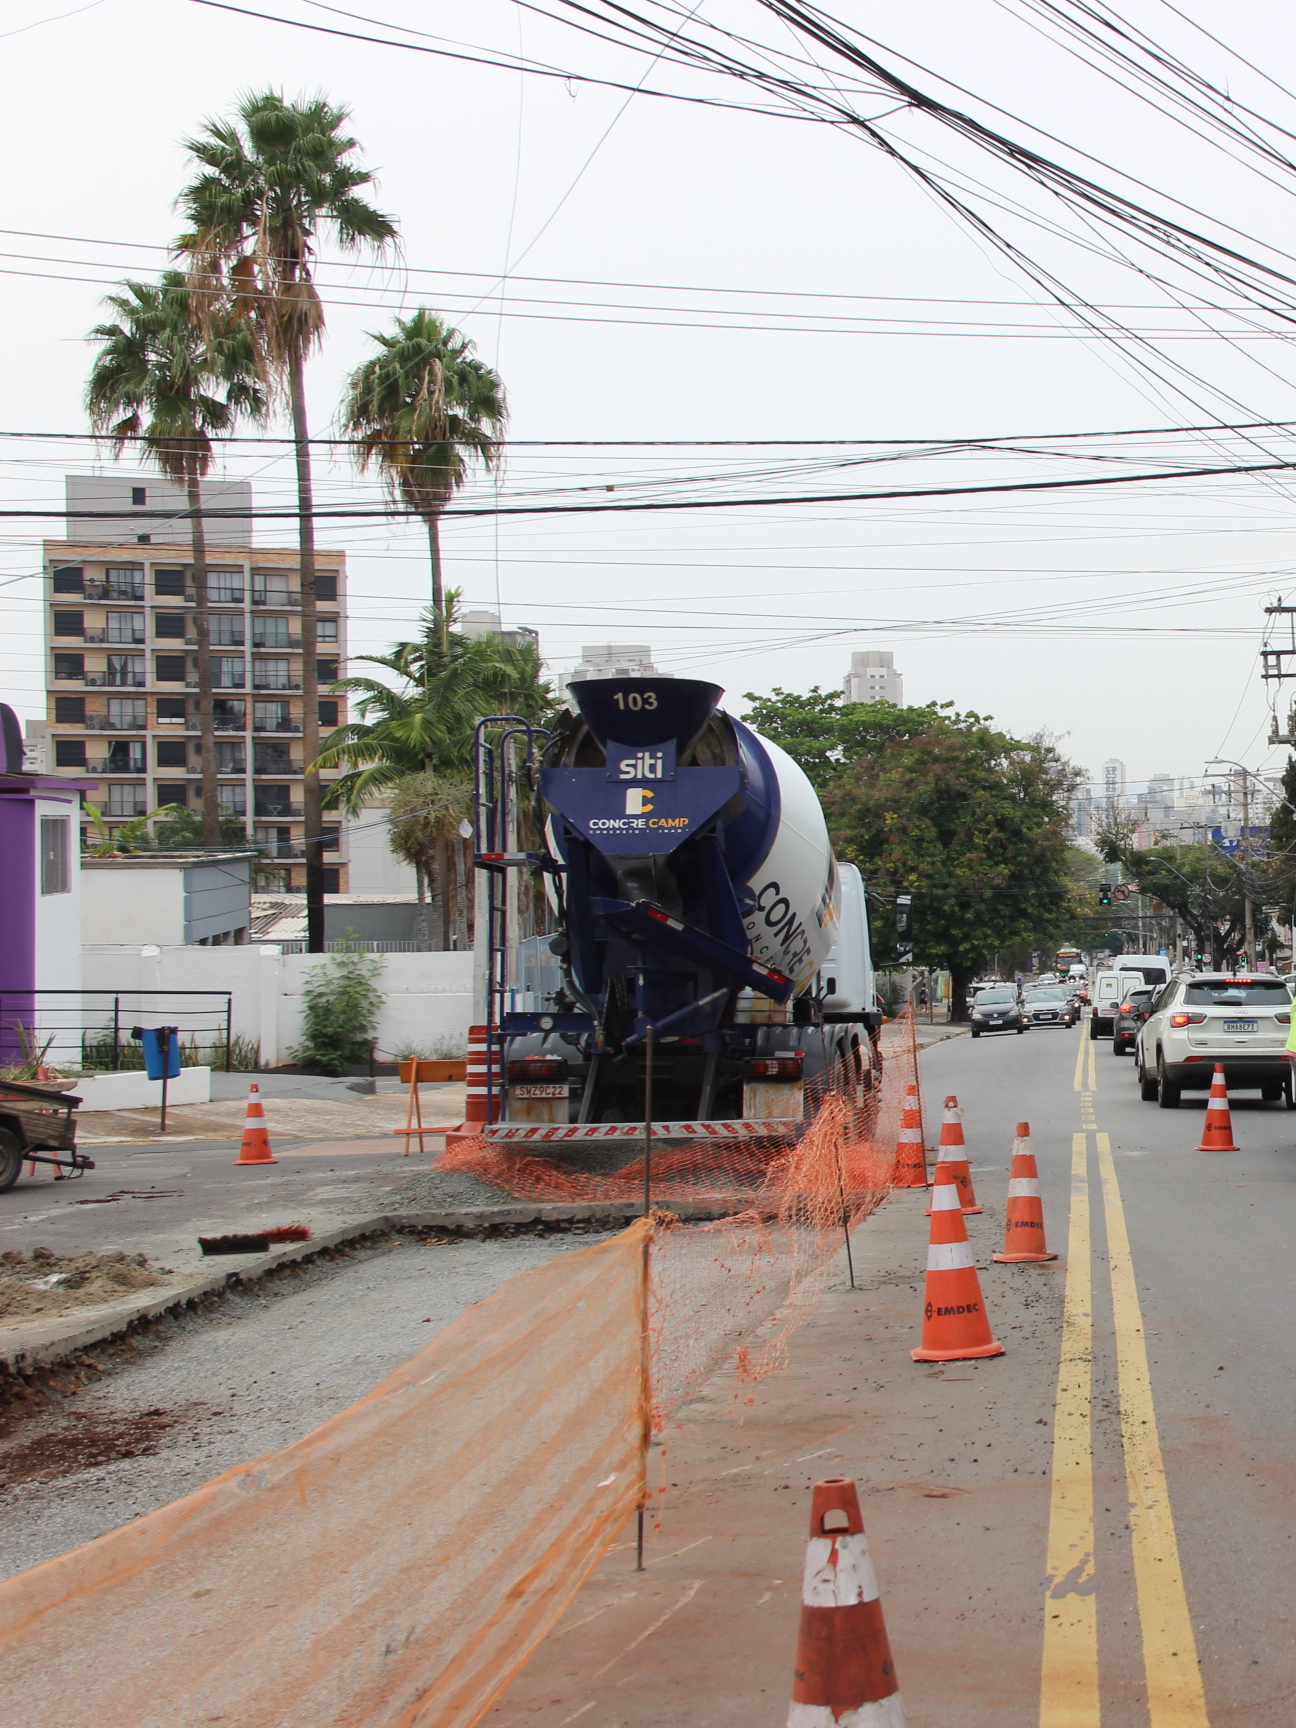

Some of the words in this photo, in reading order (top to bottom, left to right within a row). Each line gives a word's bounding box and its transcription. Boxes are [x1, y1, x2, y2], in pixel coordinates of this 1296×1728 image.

[613, 692, 659, 711] 103
[618, 751, 664, 779] siti
[588, 818, 647, 829] CONCRE
[648, 817, 690, 829] CAMP
[520, 1085, 564, 1097] SWZ9C22
[1014, 1220, 1043, 1230] EMDEC
[936, 1302, 980, 1317] EMDEC
